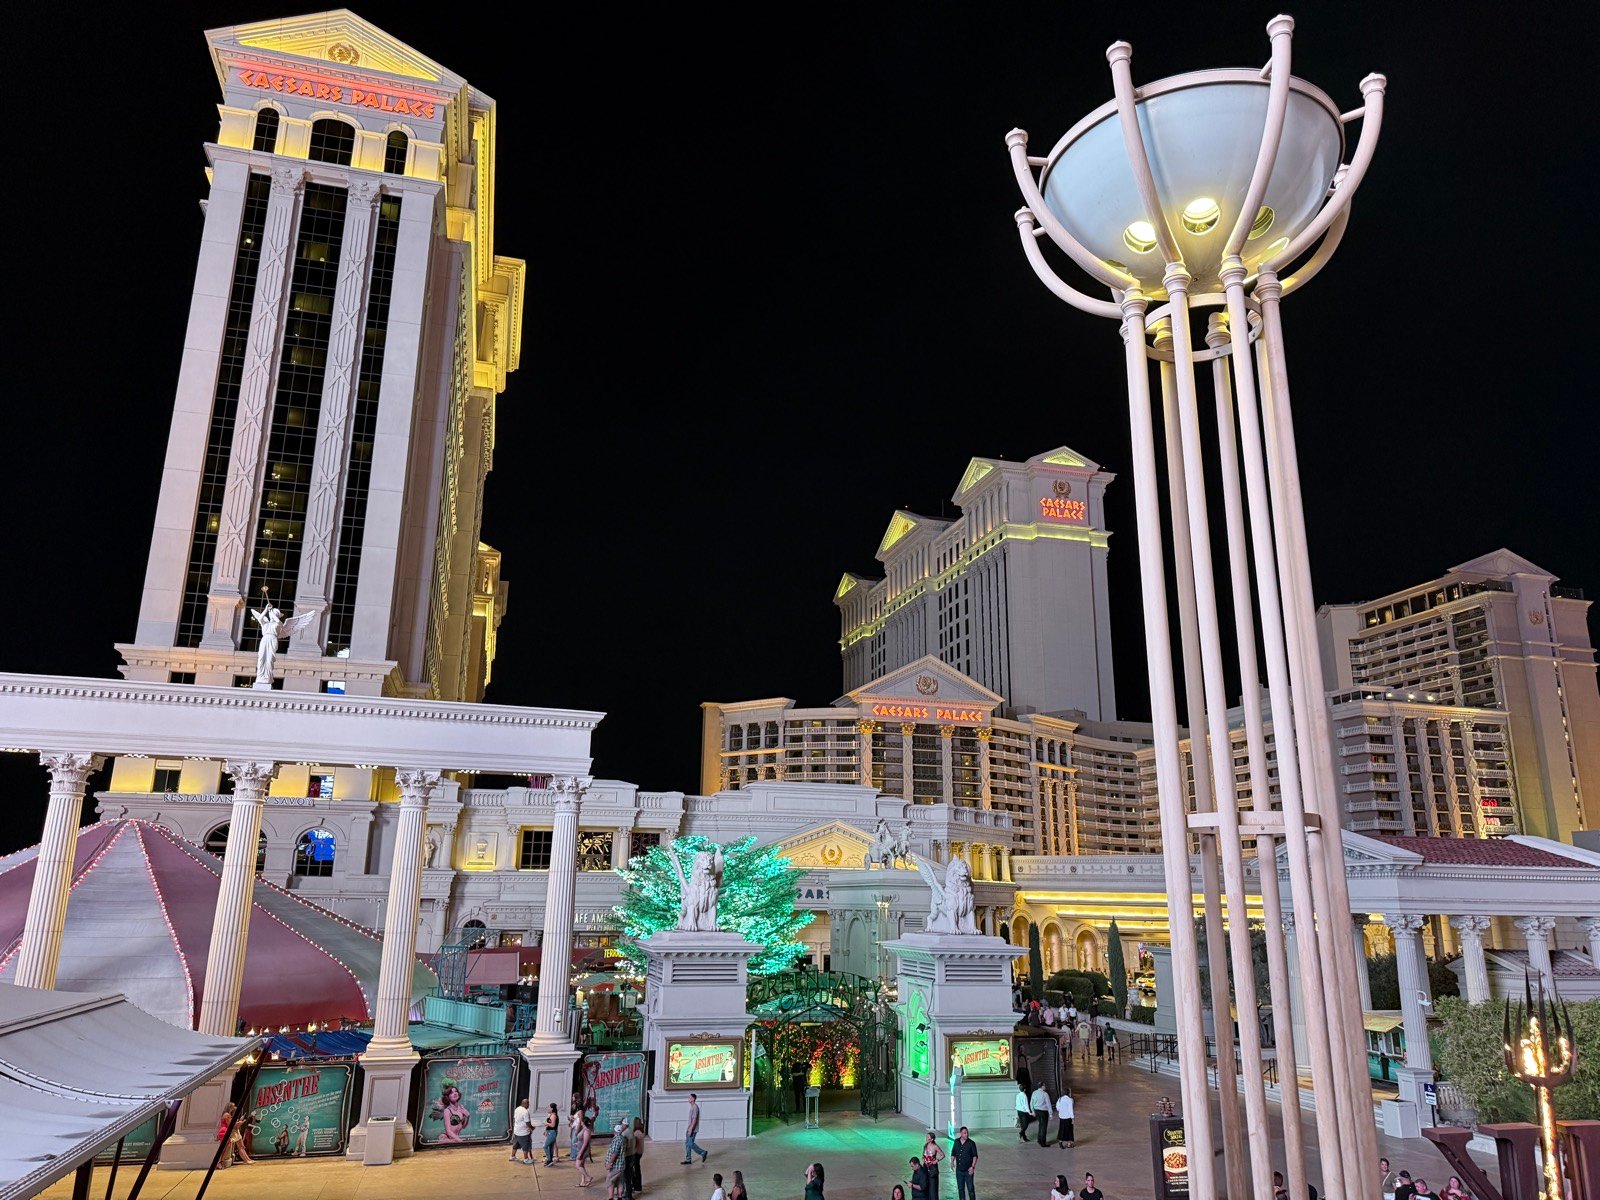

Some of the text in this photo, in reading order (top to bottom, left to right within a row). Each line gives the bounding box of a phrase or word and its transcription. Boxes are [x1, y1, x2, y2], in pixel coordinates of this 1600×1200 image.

[237, 69, 436, 119] CAESARS PALACE
[1040, 497, 1085, 511] CAESARS
[1043, 507, 1084, 520] PALACE
[872, 704, 983, 722] CAESARS PALACE
[163, 793, 234, 803] RESTAURAN
[273, 797, 313, 805] SAVOY
[574, 912, 588, 924] AFE
[746, 969, 882, 1005] GREEN FAIRY
[695, 1052, 723, 1069] ABSINTHE
[595, 1062, 640, 1089] ABSINTHE
